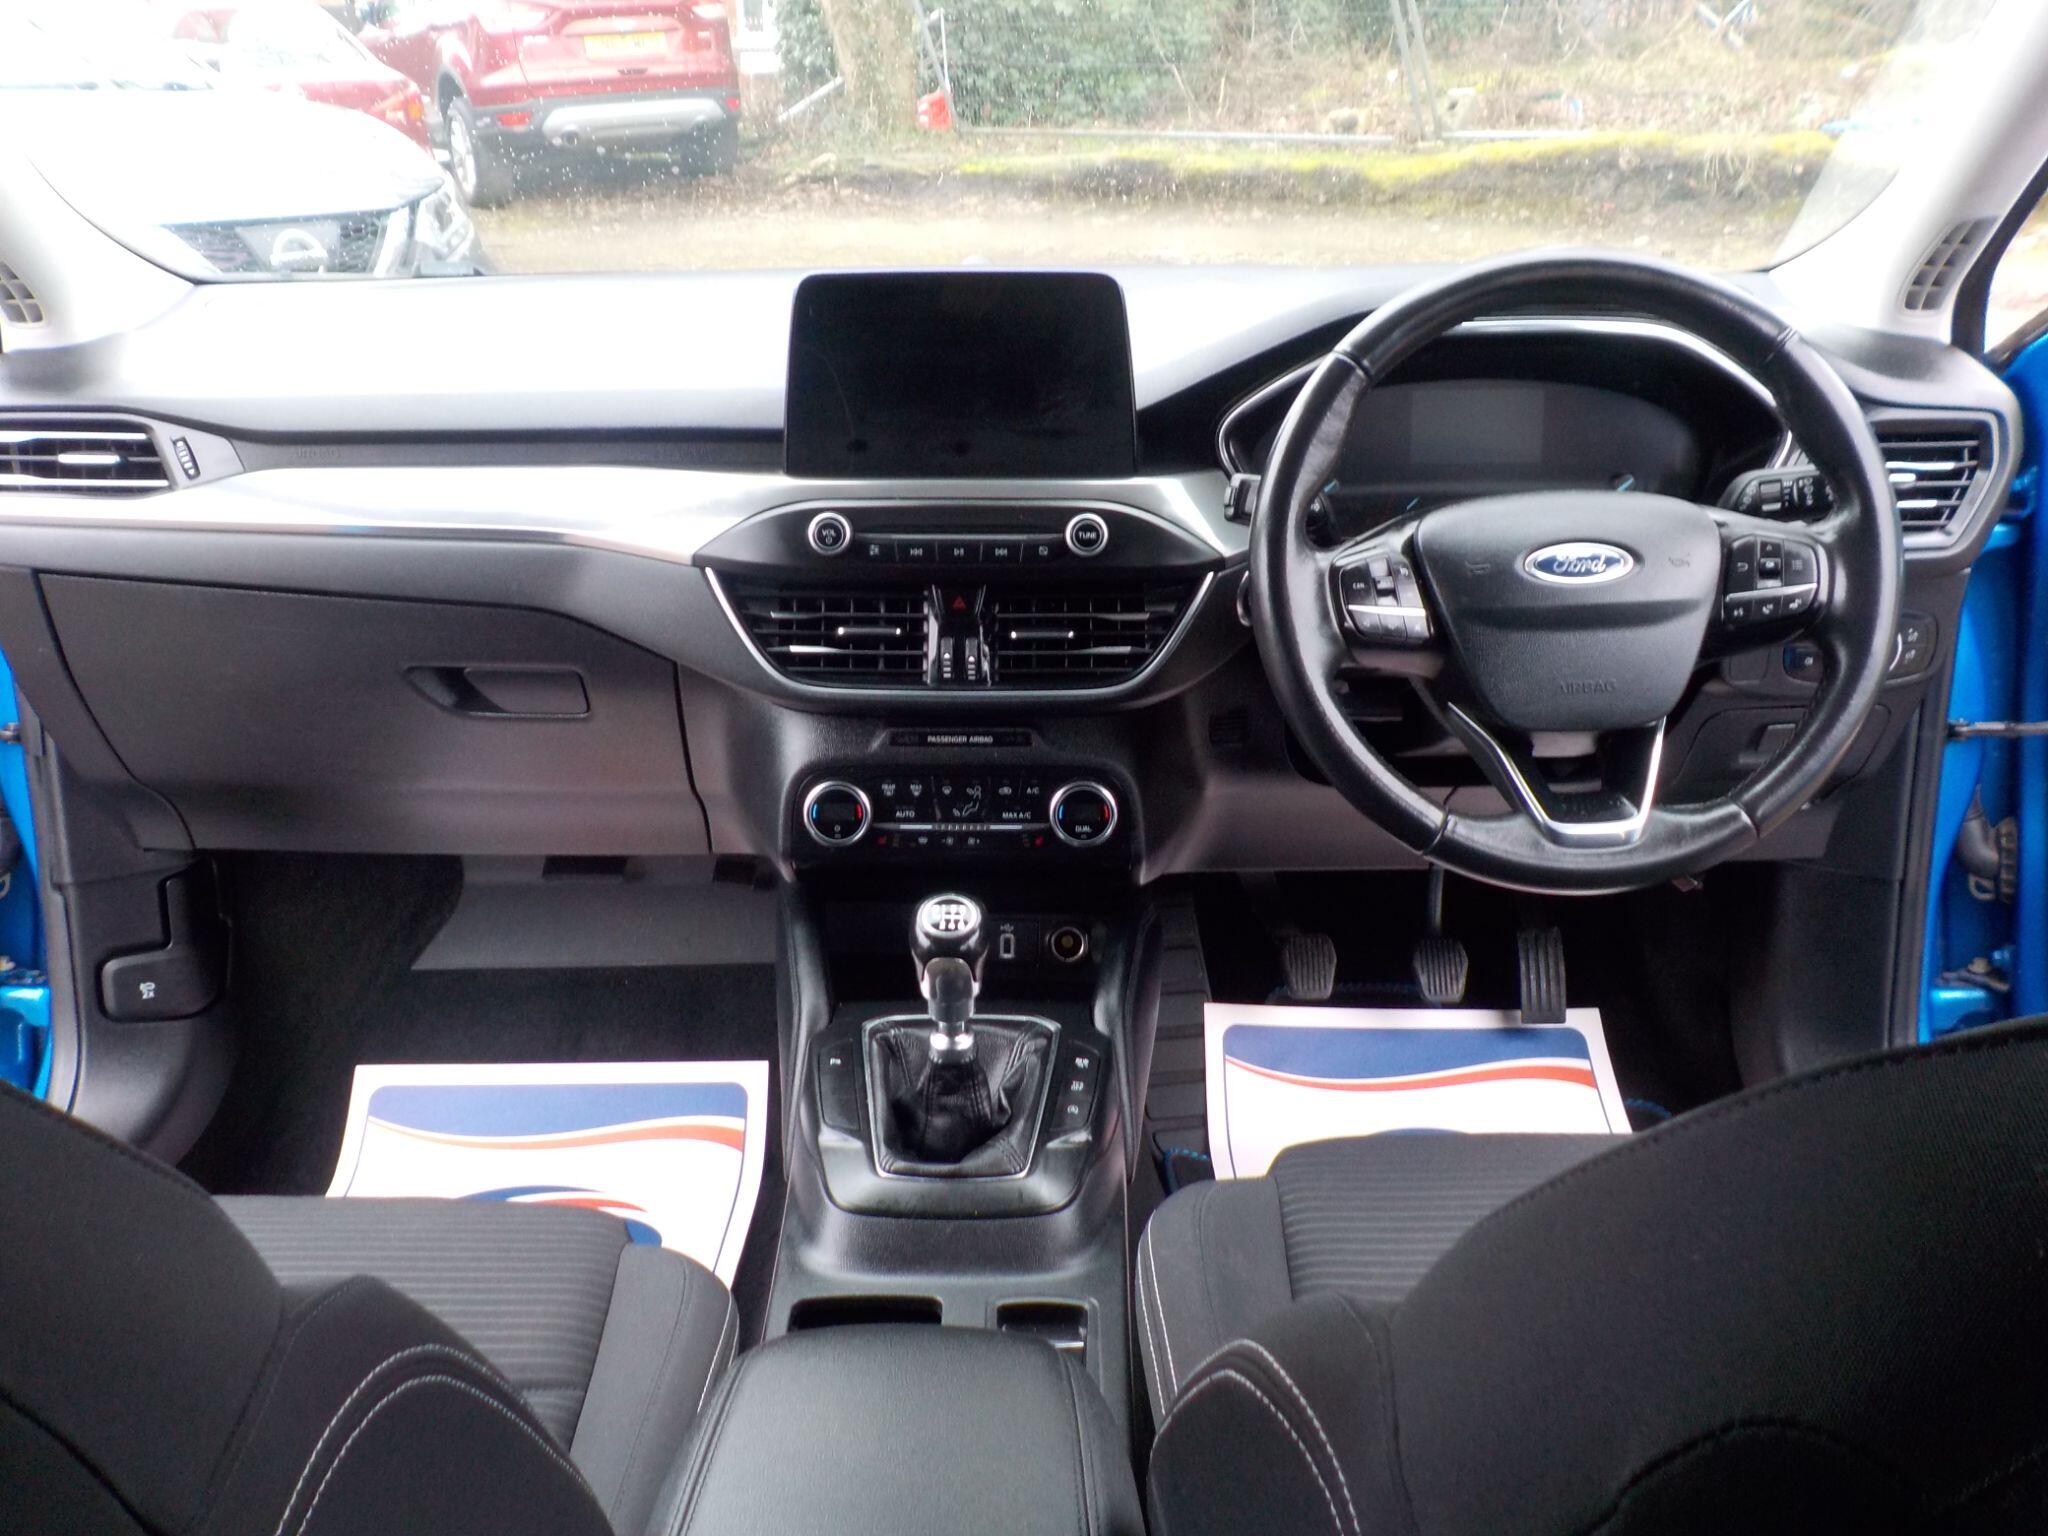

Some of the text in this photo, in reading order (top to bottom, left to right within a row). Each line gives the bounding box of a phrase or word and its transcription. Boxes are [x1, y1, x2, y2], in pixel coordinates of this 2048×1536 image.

[1079, 530, 1097, 540] TUNE
[1553, 553, 1607, 573] Ford
[927, 734, 994, 744] PASSENGER AIRBAG
[1026, 786, 1040, 795] A/C
[895, 810, 916, 818] AUTO
[1002, 811, 1018, 819] MAX
